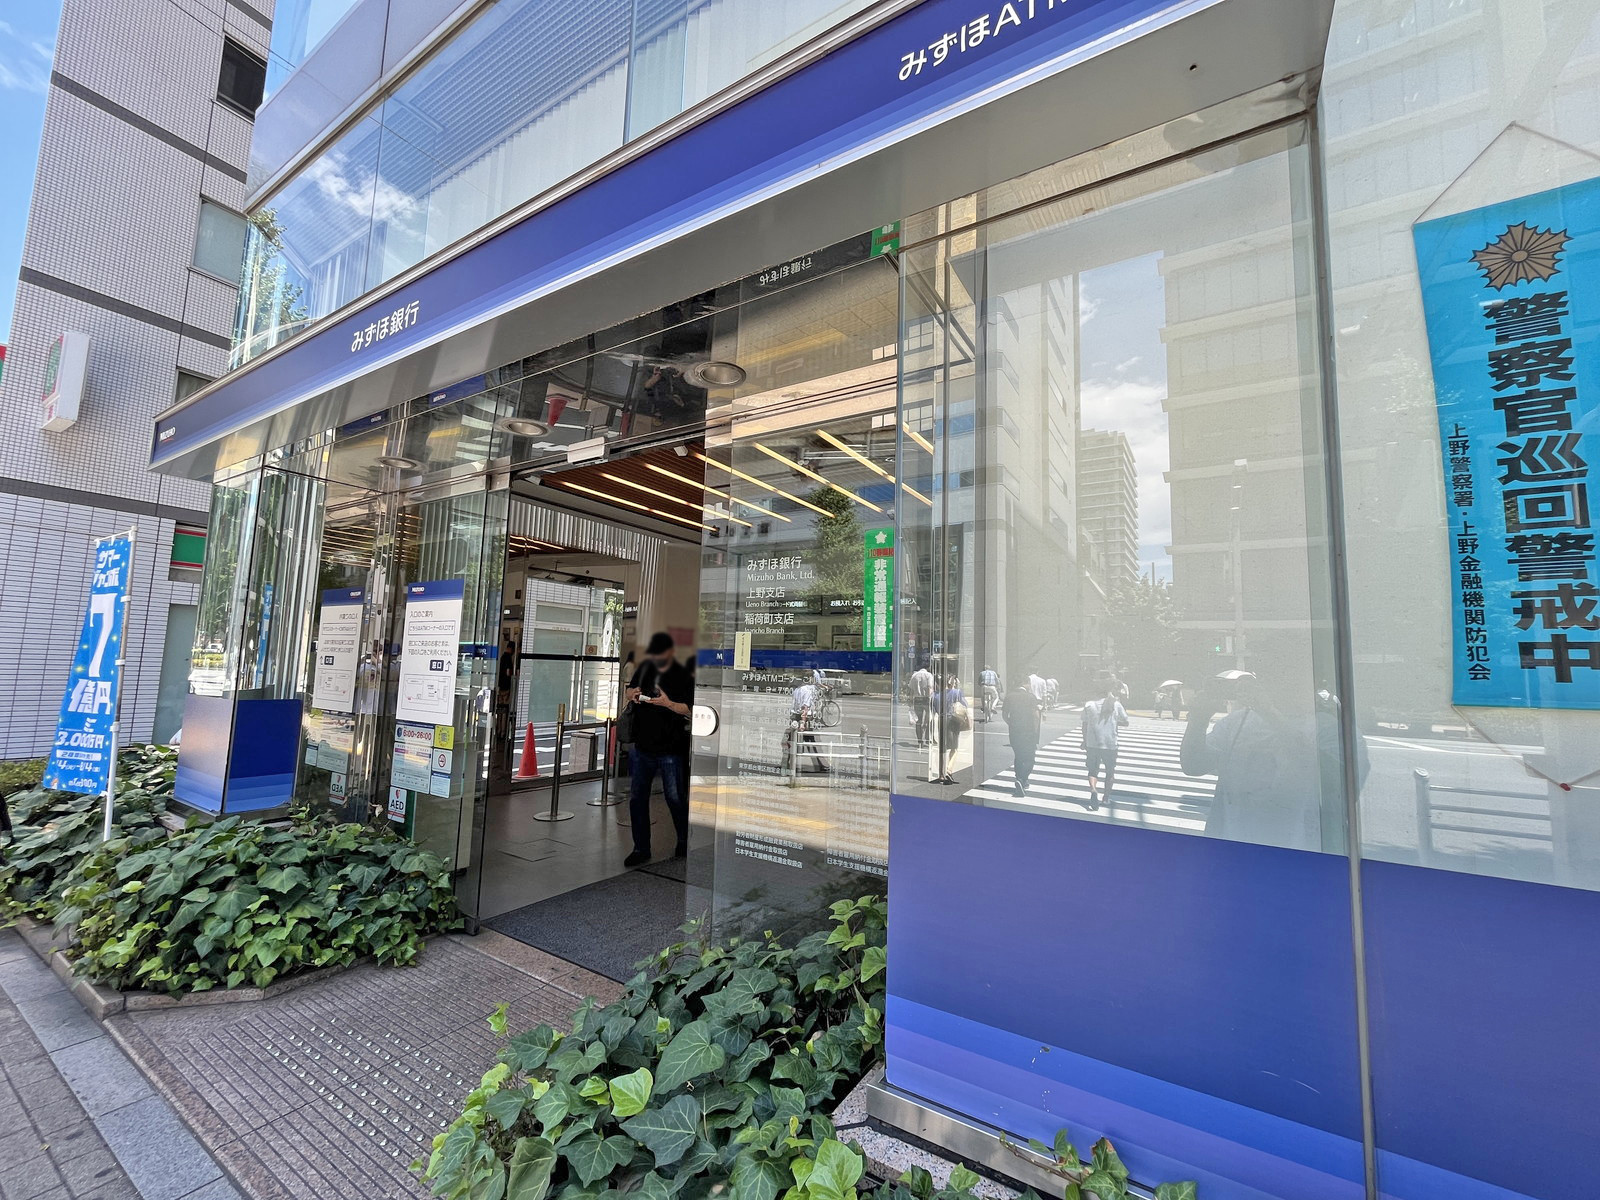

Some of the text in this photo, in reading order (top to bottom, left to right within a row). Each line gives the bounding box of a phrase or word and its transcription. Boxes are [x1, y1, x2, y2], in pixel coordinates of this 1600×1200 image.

[351, 300, 420, 353] みずほ銀行
[1483, 290, 1600, 683] 警察官巡回警戒中
[96, 549, 121, 569] サマー
[1448, 423, 1491, 681] 上野警察署・上野金融機関防犯会
[747, 556, 802, 571] みずほ銀行
[746, 569, 815, 582] Mizuho Bank, Ltd.
[746, 587, 786, 599] 上野支店
[760, 600, 779, 608] Branch
[744, 613, 795, 625] 稲荷町支店
[741, 672, 802, 683] みずほATMコーナー
[67, 679, 112, 714] 億円
[390, 799, 404, 811] AED
